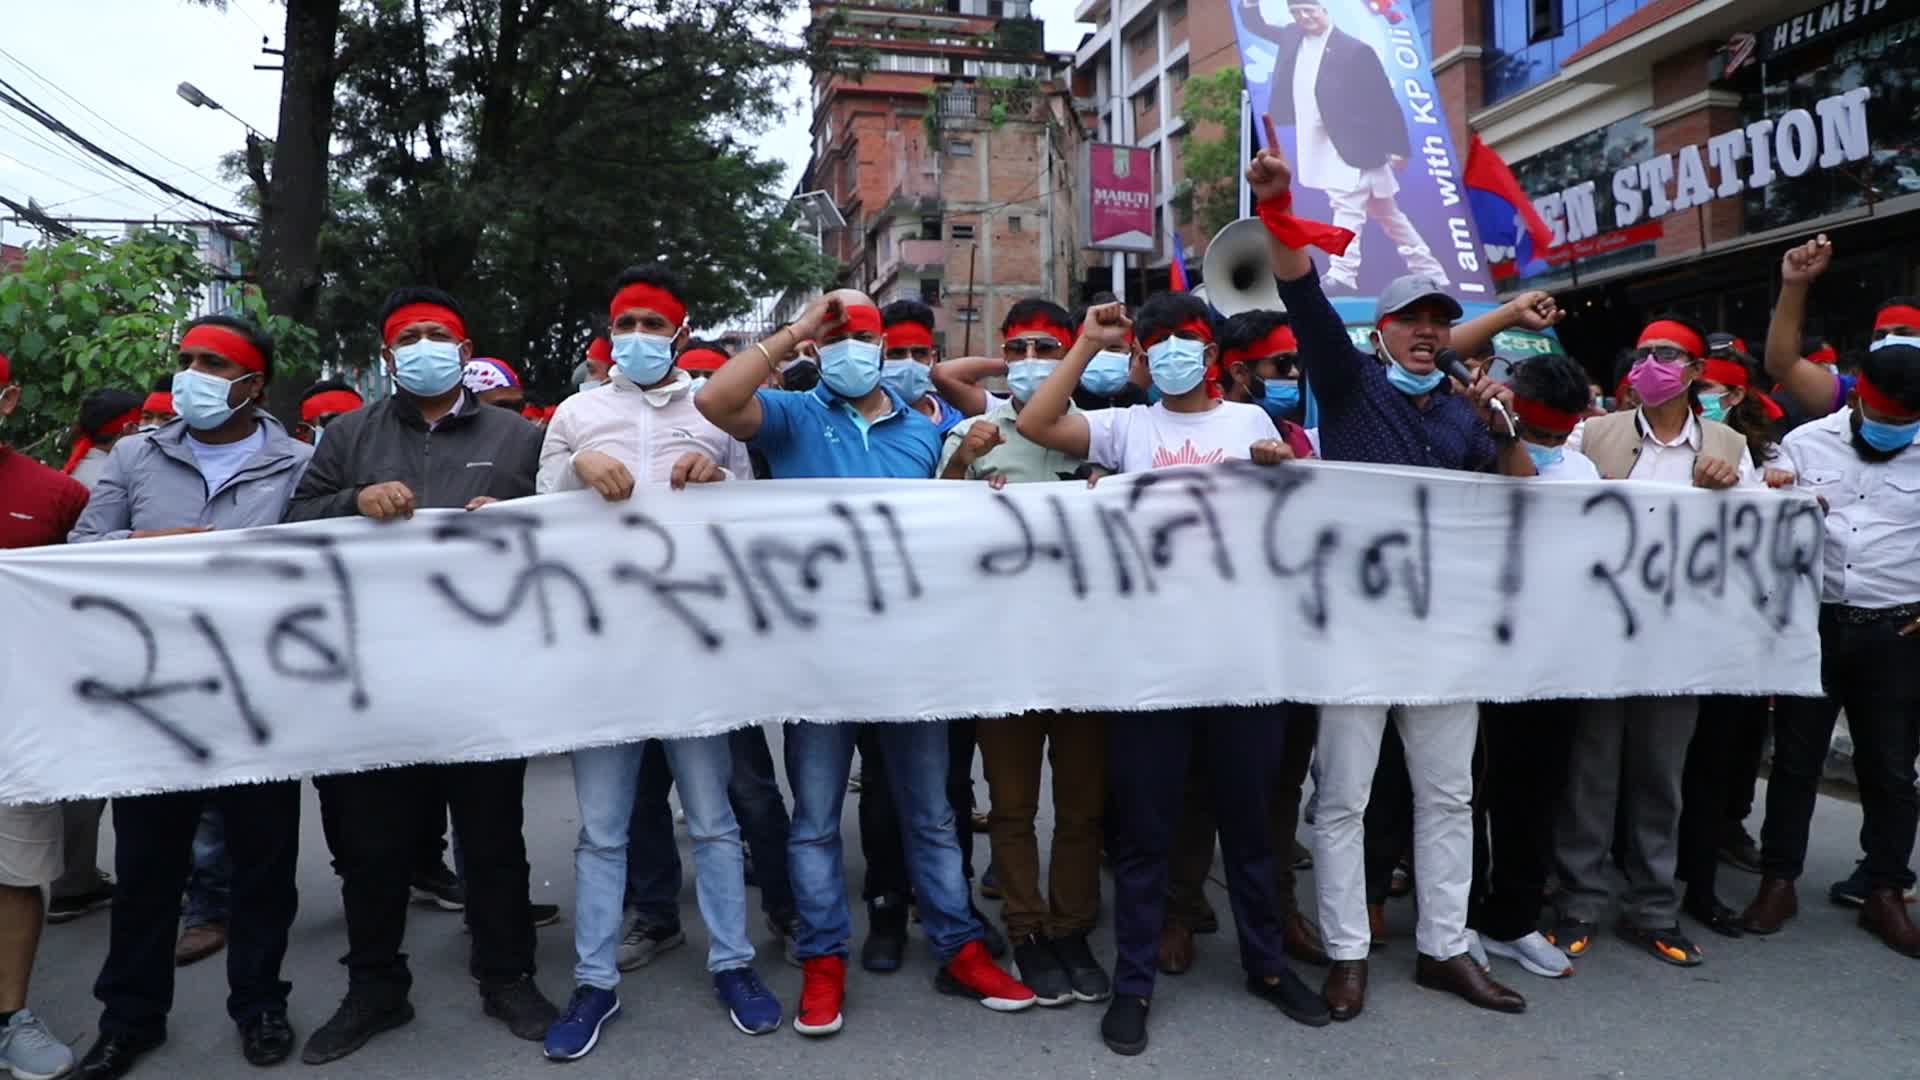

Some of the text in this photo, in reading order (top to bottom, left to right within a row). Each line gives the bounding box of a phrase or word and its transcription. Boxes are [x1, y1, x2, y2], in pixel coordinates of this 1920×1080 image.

[1094, 188, 1149, 206] MARUTI
[1388, 28, 1485, 293] I am with KP Oli
[1612, 86, 1871, 229] STATION
